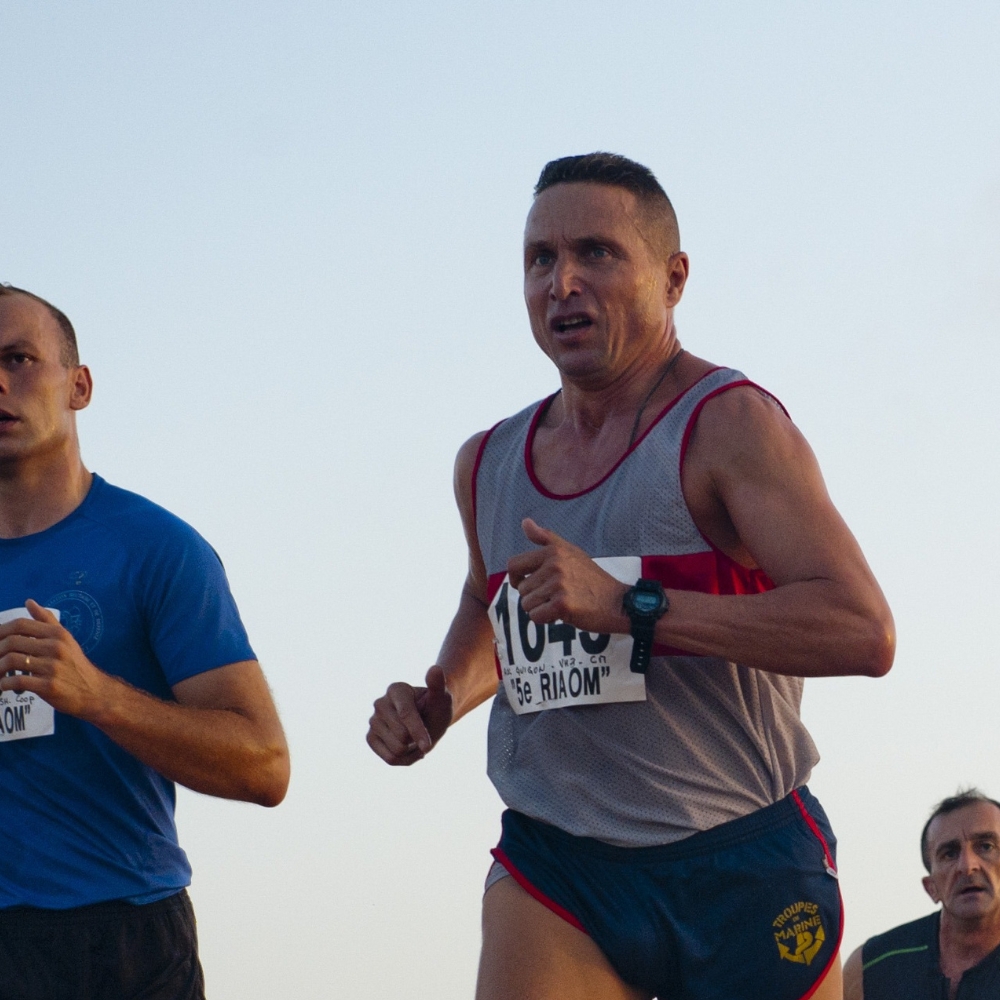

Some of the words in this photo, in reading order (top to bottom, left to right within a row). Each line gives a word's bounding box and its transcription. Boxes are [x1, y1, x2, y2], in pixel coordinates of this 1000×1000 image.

[495, 582, 611, 667] 164
[540, 666, 611, 701] RIAOM"
[772, 901, 819, 928] TROUPES
[774, 915, 822, 943] MARINE
